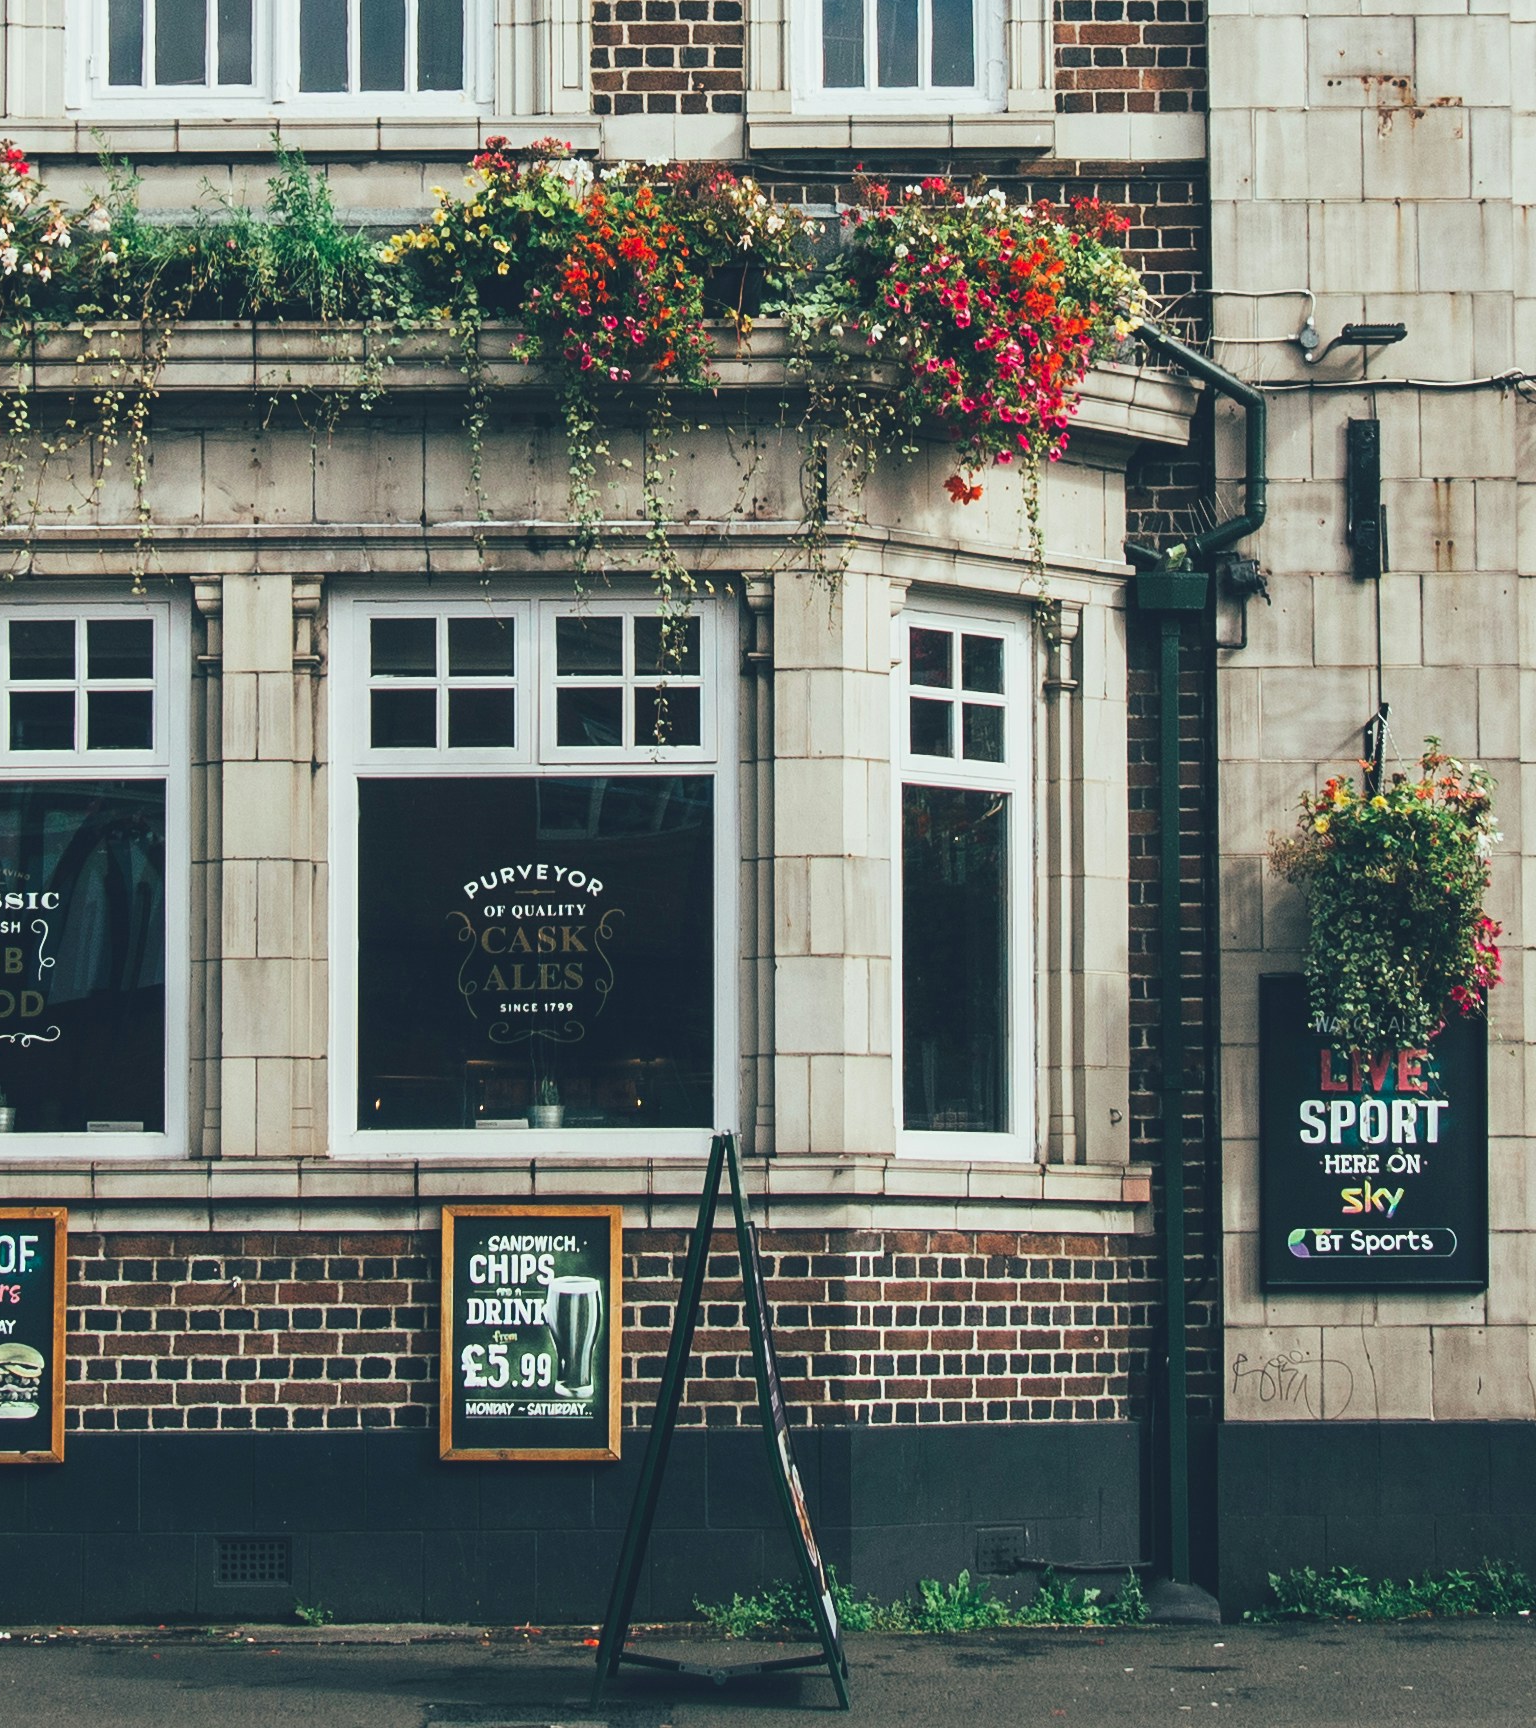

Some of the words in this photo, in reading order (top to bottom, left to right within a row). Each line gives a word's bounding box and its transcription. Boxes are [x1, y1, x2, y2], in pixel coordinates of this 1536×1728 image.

[463, 864, 604, 900] PURVEYOR
[483, 905, 506, 918] OF
[511, 904, 586, 920] QUALITY
[480, 925, 589, 954] CASK
[482, 962, 584, 991] ALES
[499, 1003, 539, 1014] SINCE
[544, 1002, 574, 1013] 1799
[1320, 1048, 1429, 1092] LIVE
[1299, 1099, 1450, 1144] SPORT
[1324, 1154, 1380, 1174] HERE
[1387, 1154, 1421, 1174] ON
[1340, 1180, 1405, 1219] sky
[487, 1234, 581, 1254] SANDWICH,
[1315, 1234, 1344, 1252] BT
[1350, 1229, 1434, 1256] Sports
[469, 1253, 556, 1286] CHIPS
[465, 1297, 551, 1326] DRINK
[461, 1344, 552, 1389] £5.99
[465, 1402, 514, 1416] MONDAY
